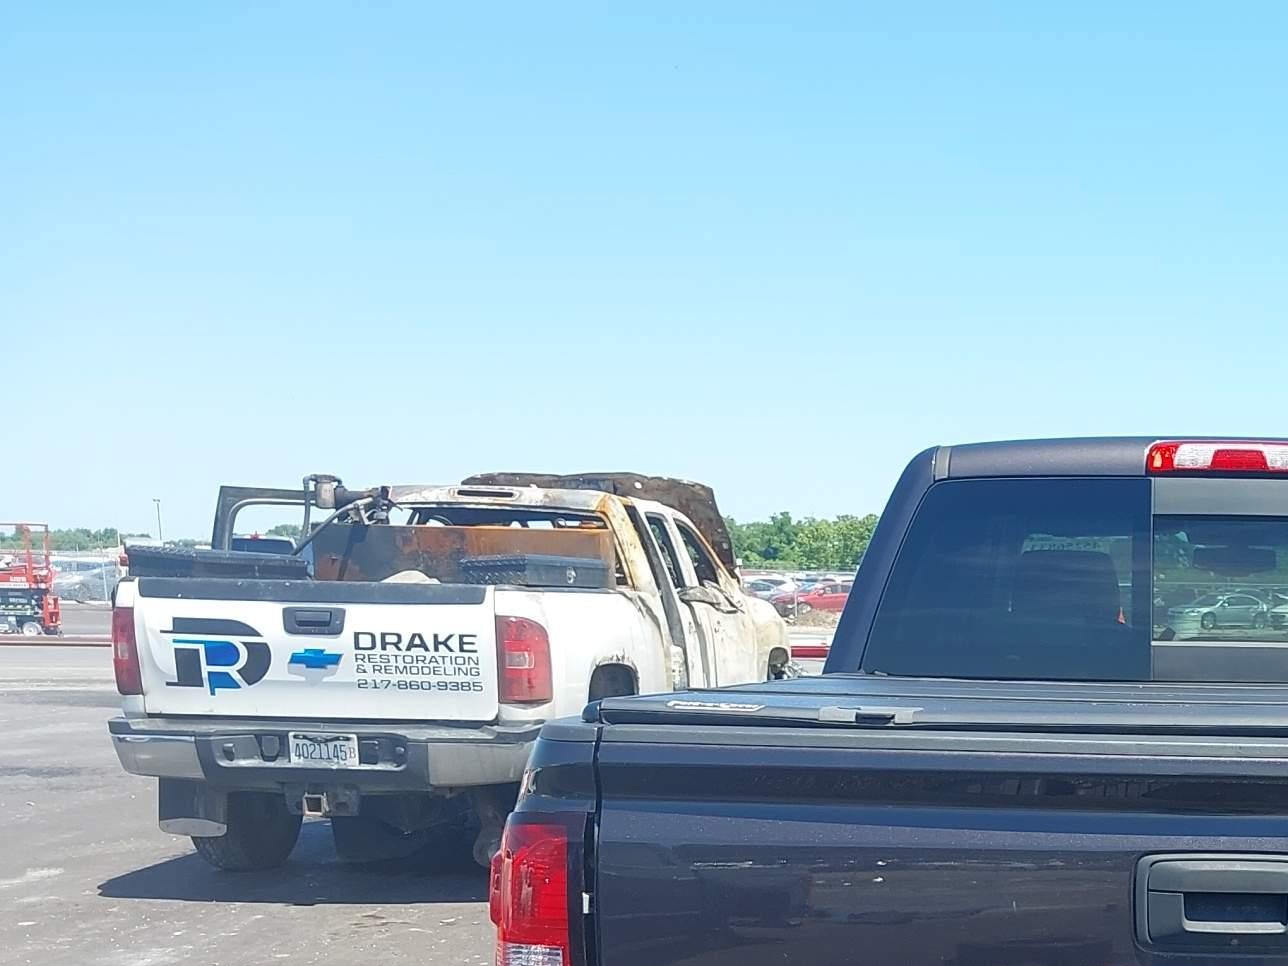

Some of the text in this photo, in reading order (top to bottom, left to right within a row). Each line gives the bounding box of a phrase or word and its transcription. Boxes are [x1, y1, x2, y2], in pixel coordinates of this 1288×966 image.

[353, 631, 479, 653] DRAKE
[354, 653, 480, 666] RESTORATION
[356, 664, 481, 677] & REMODELING
[357, 678, 483, 692] 217-860-9385
[294, 743, 348, 761] 4021145
